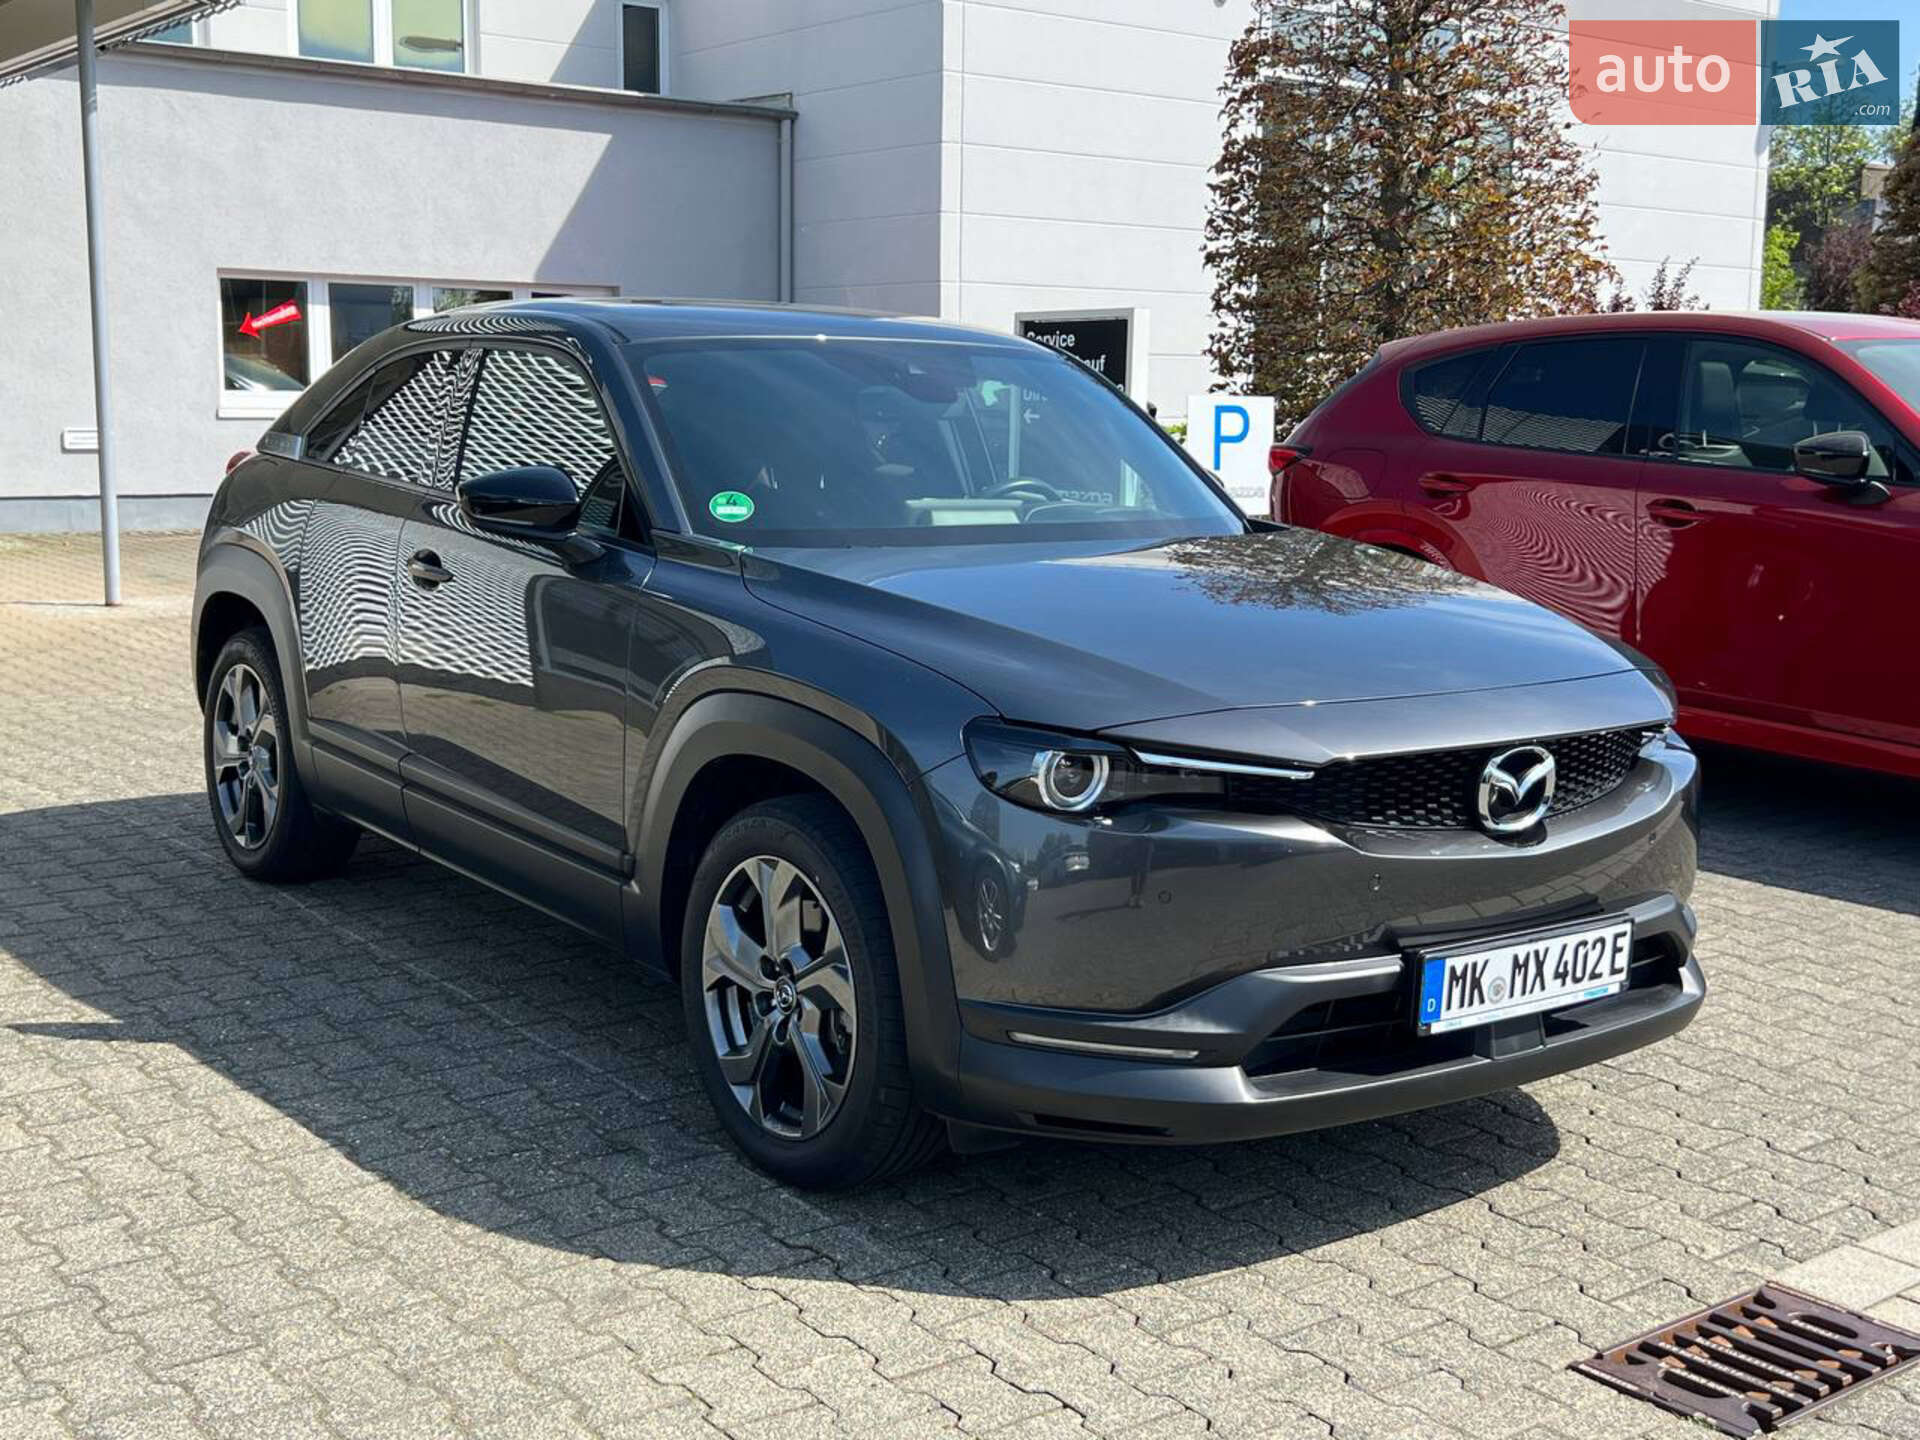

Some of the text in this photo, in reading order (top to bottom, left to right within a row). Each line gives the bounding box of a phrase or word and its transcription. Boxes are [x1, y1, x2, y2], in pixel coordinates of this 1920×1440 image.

[1213, 404, 1250, 471] P
[1445, 931, 1628, 1011] MK MX 402E
[1426, 998, 1436, 1013] D
